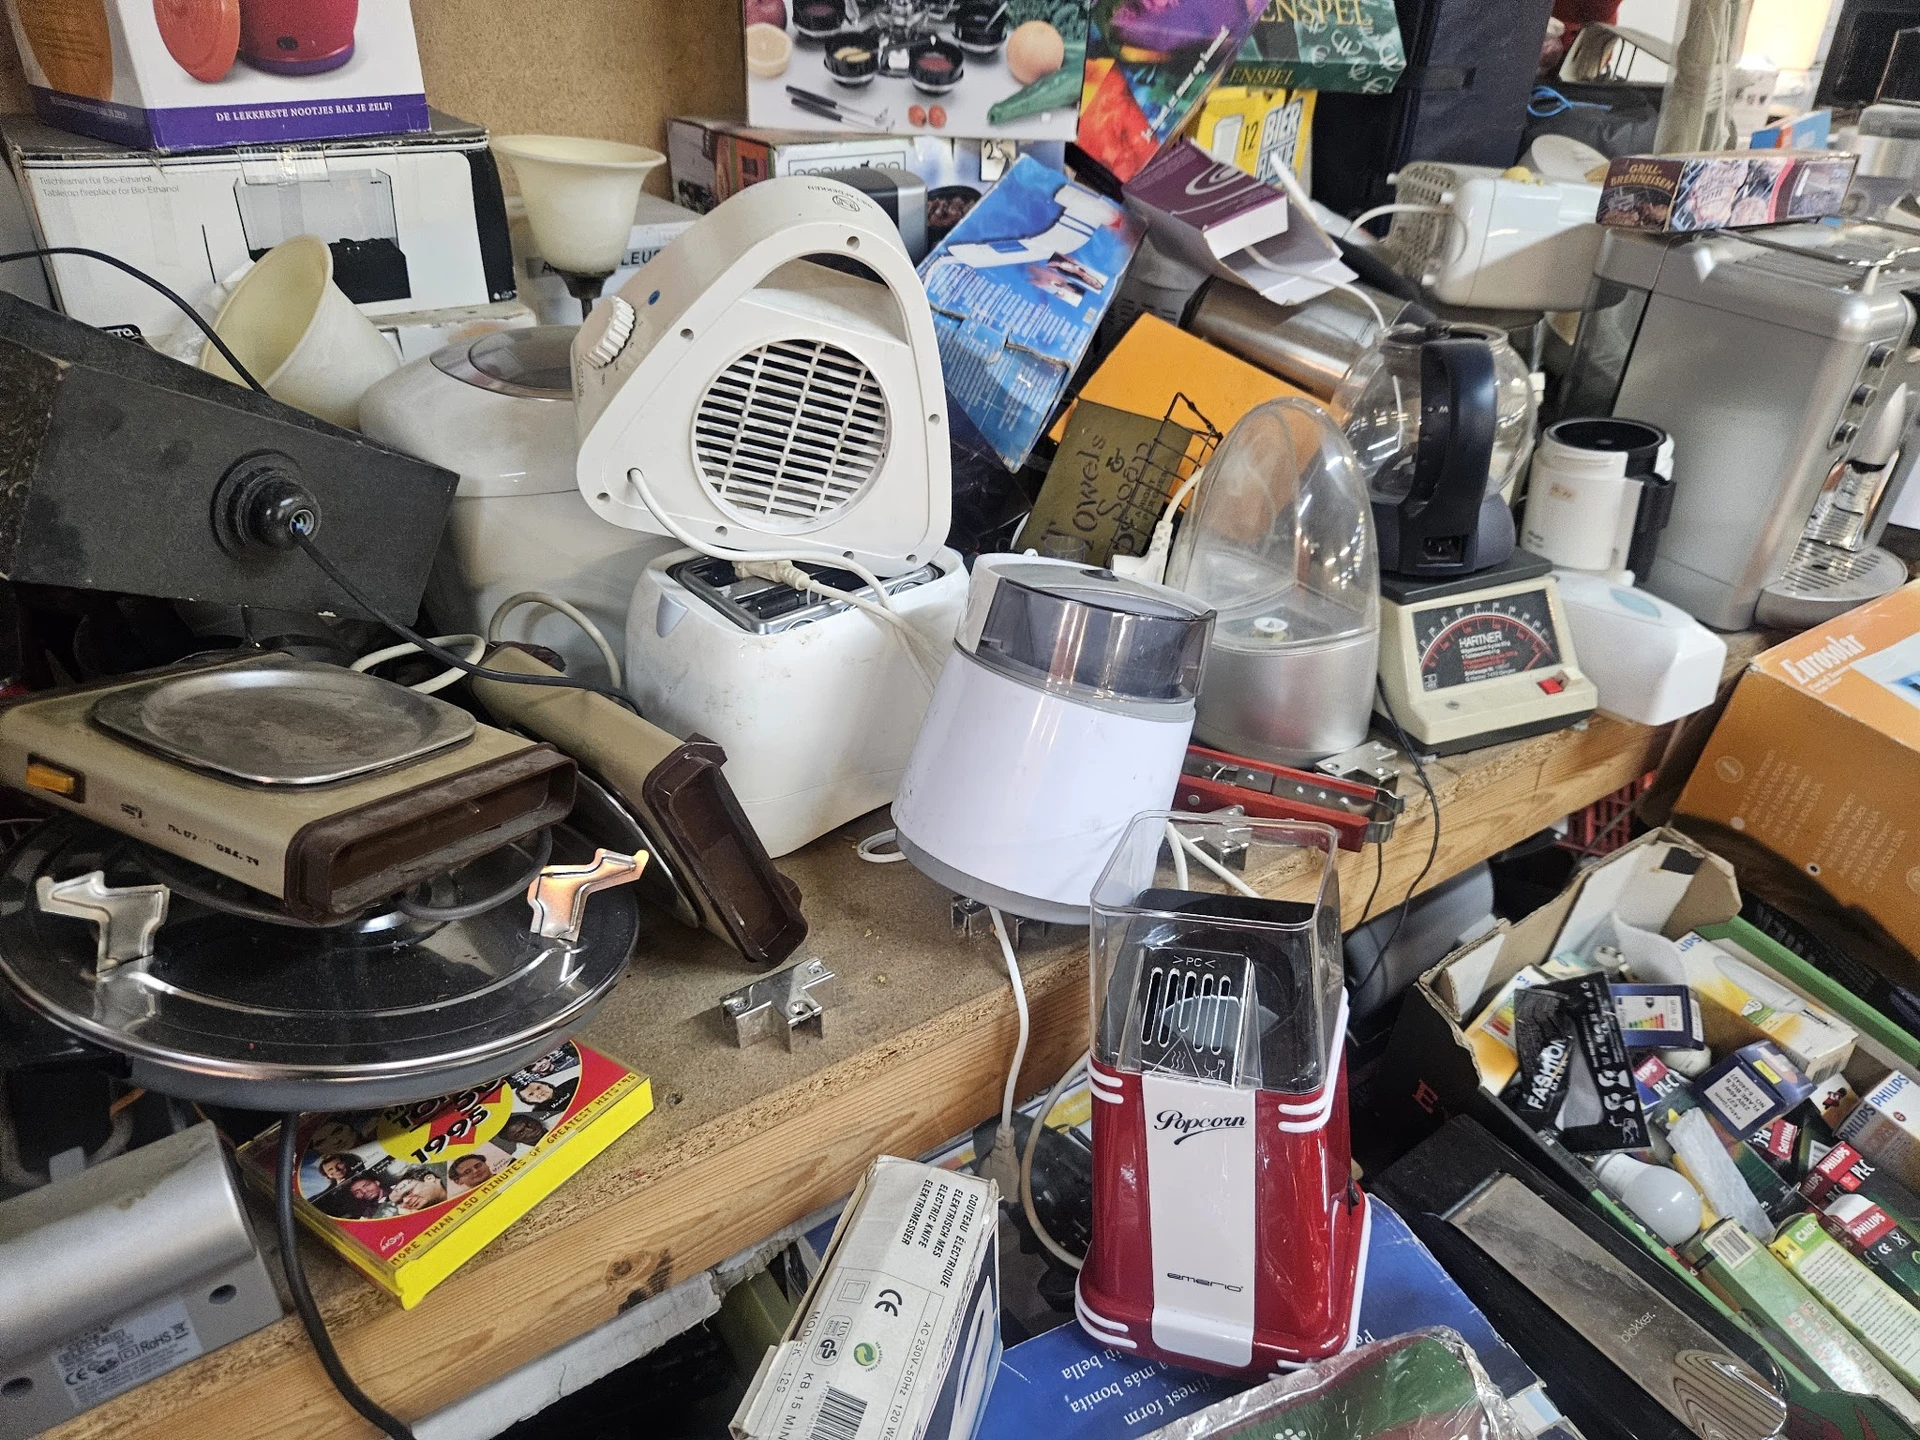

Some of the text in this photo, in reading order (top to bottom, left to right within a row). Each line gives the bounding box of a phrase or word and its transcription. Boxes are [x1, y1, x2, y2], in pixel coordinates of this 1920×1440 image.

[1228, 67, 1295, 85] ENSPEL
[216, 102, 393, 121] DE LEKKERSTE NOOTJES BAK JE ZELF!
[1243, 121, 1259, 153] 12
[102, 175, 152, 184] Bio-Ethanol
[131, 186, 180, 195] Bio-Ethanol
[1459, 630, 1503, 648] HARTNER
[1780, 633, 1866, 685] Eurosolar
[1870, 1074, 1910, 1107] PHILIPS
[410, 1104, 492, 1164] 1995
[1153, 1108, 1247, 1141] Popcorn
[1840, 1103, 1877, 1142] PHILIPS
[1778, 1121, 1795, 1154] PHILIPS
[1820, 1146, 1851, 1173] PHILIPS
[390, 1241, 421, 1266] MORE
[424, 1215, 454, 1238] THAN
[456, 1196, 479, 1214] 150
[482, 1159, 527, 1195] MINUTES
[546, 1107, 592, 1144] GREATEST
[901, 1179, 933, 1246] ELEKTROMESSER
[918, 1183, 949, 1248] ELECTRIC KNIFE
[932, 1188, 964, 1258] ELEKTRISCH MES
[959, 1193, 979, 1233] COUTEAU
[1852, 1212, 1886, 1238] PHILIPS
[1167, 1271, 1244, 1293] emerio
[139, 1331, 172, 1353] RoHS
[917, 1321, 932, 1337] AC
[819, 1338, 838, 1360] GS
[1061, 1354, 1104, 1380] bella
[1123, 1365, 1156, 1388] más
[891, 1403, 904, 1423] 120
[1123, 1376, 1212, 1426] finest form
